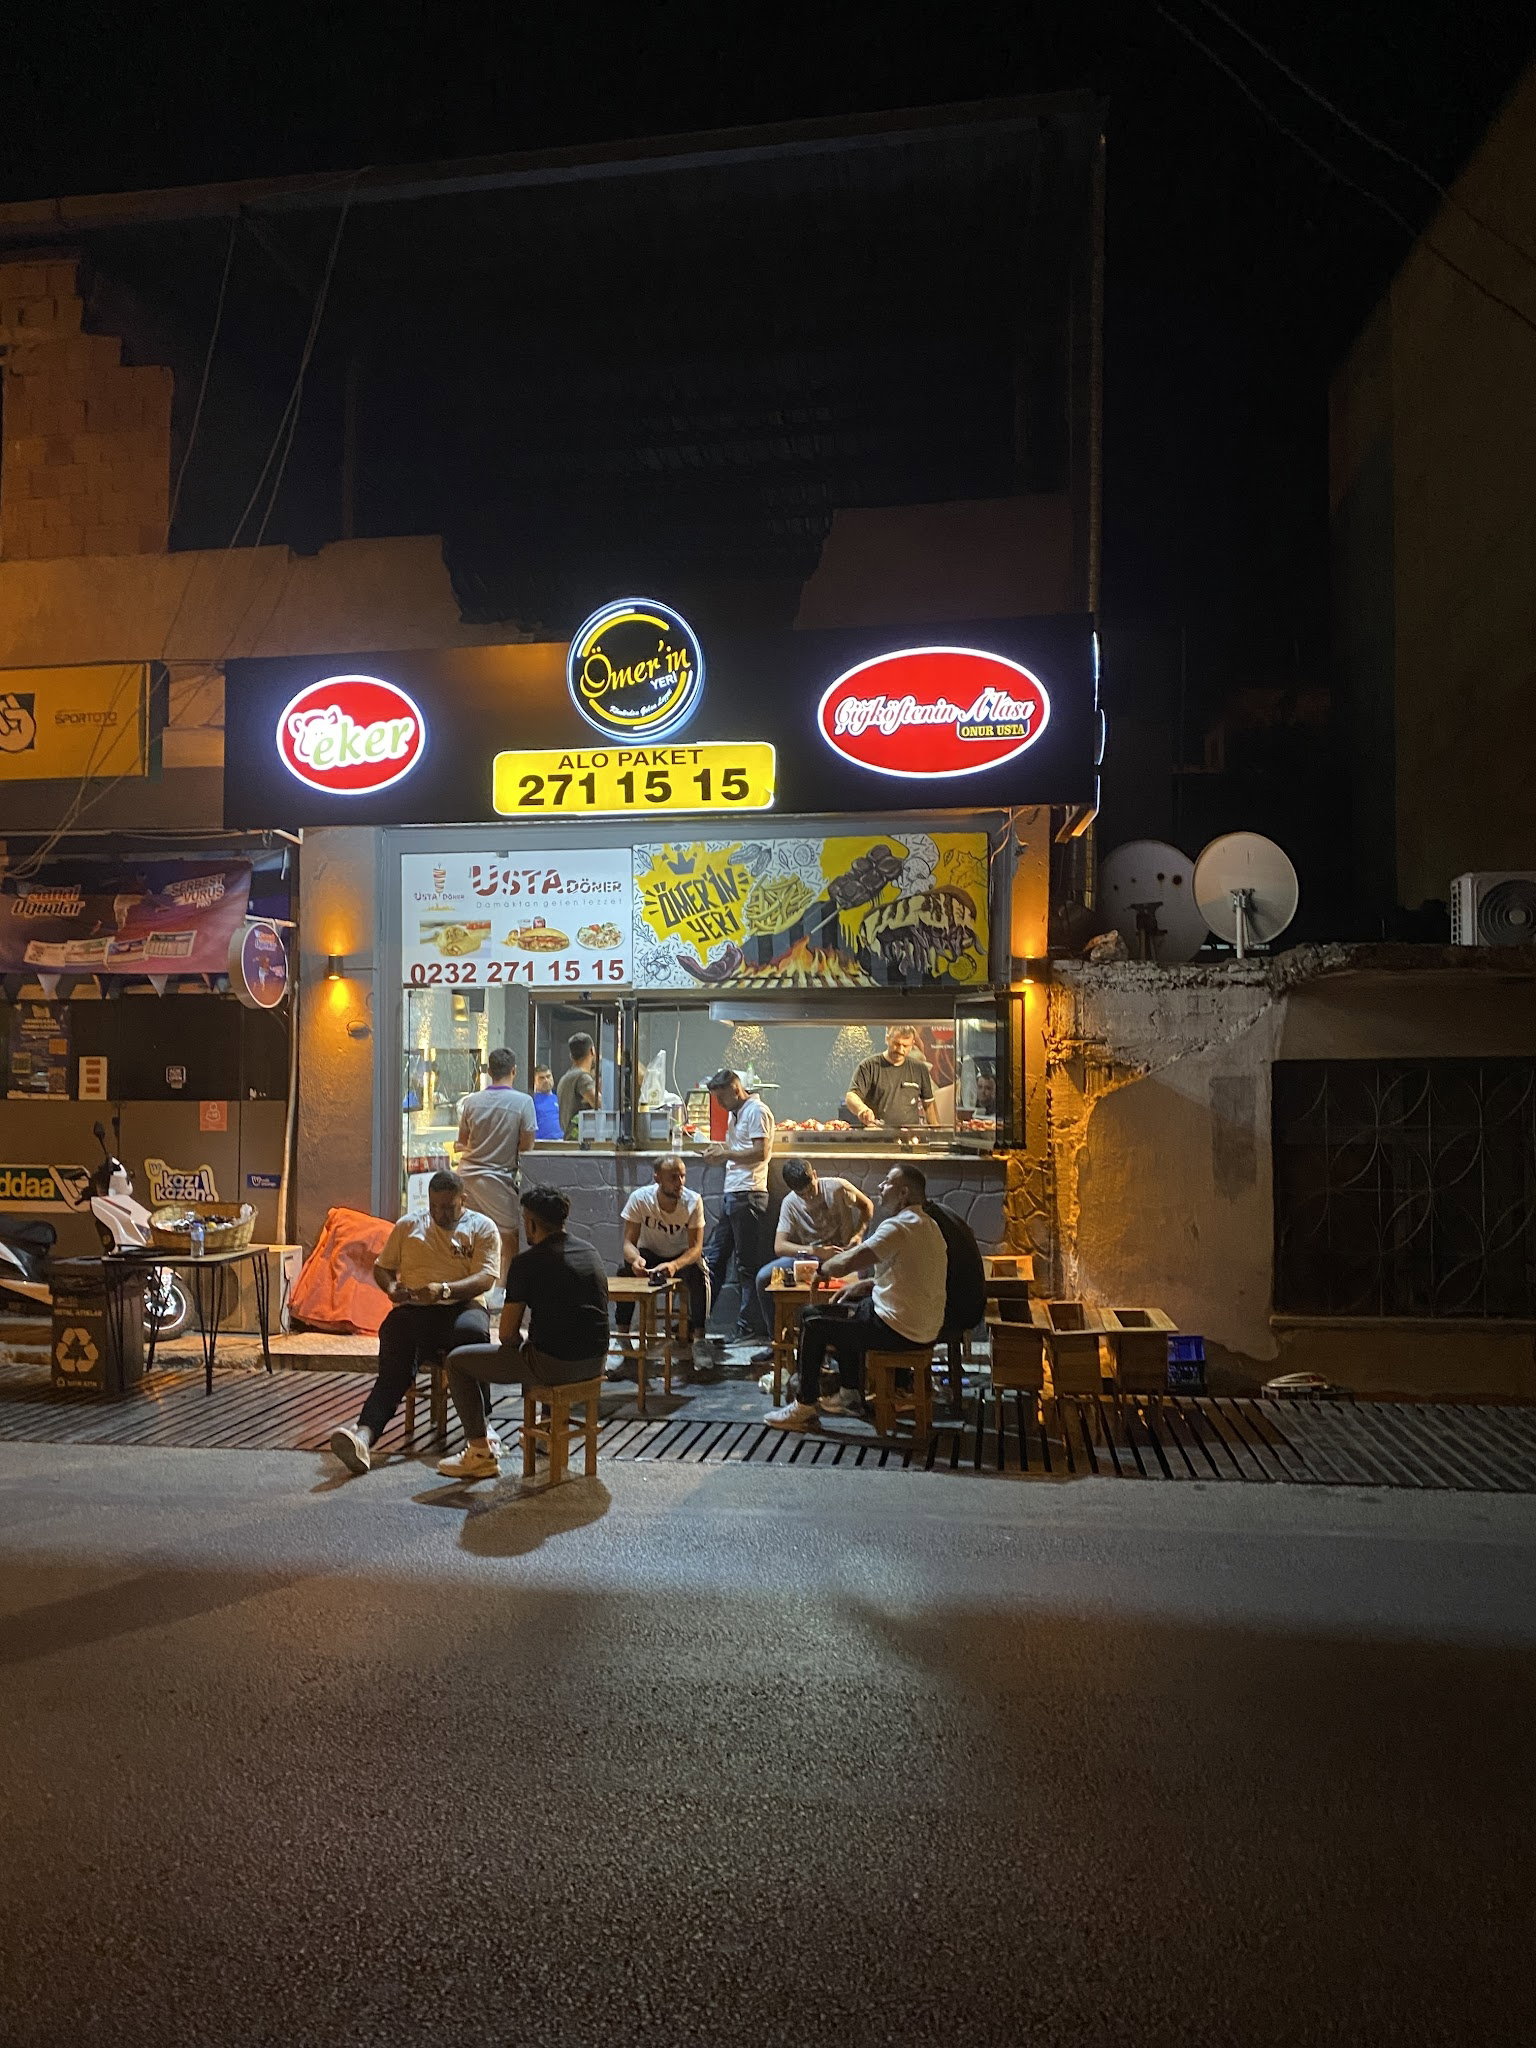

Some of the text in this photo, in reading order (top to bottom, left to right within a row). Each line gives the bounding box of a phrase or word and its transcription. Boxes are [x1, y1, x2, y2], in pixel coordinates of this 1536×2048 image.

[580, 640, 691, 698] Ömer'in
[961, 723, 1025, 737] ONUR USTA
[558, 749, 703, 770] ALO PAKET
[518, 768, 750, 806] 271 15 15
[471, 865, 622, 897] USTA DÖNER
[410, 959, 624, 985] 0232 271 15 15
